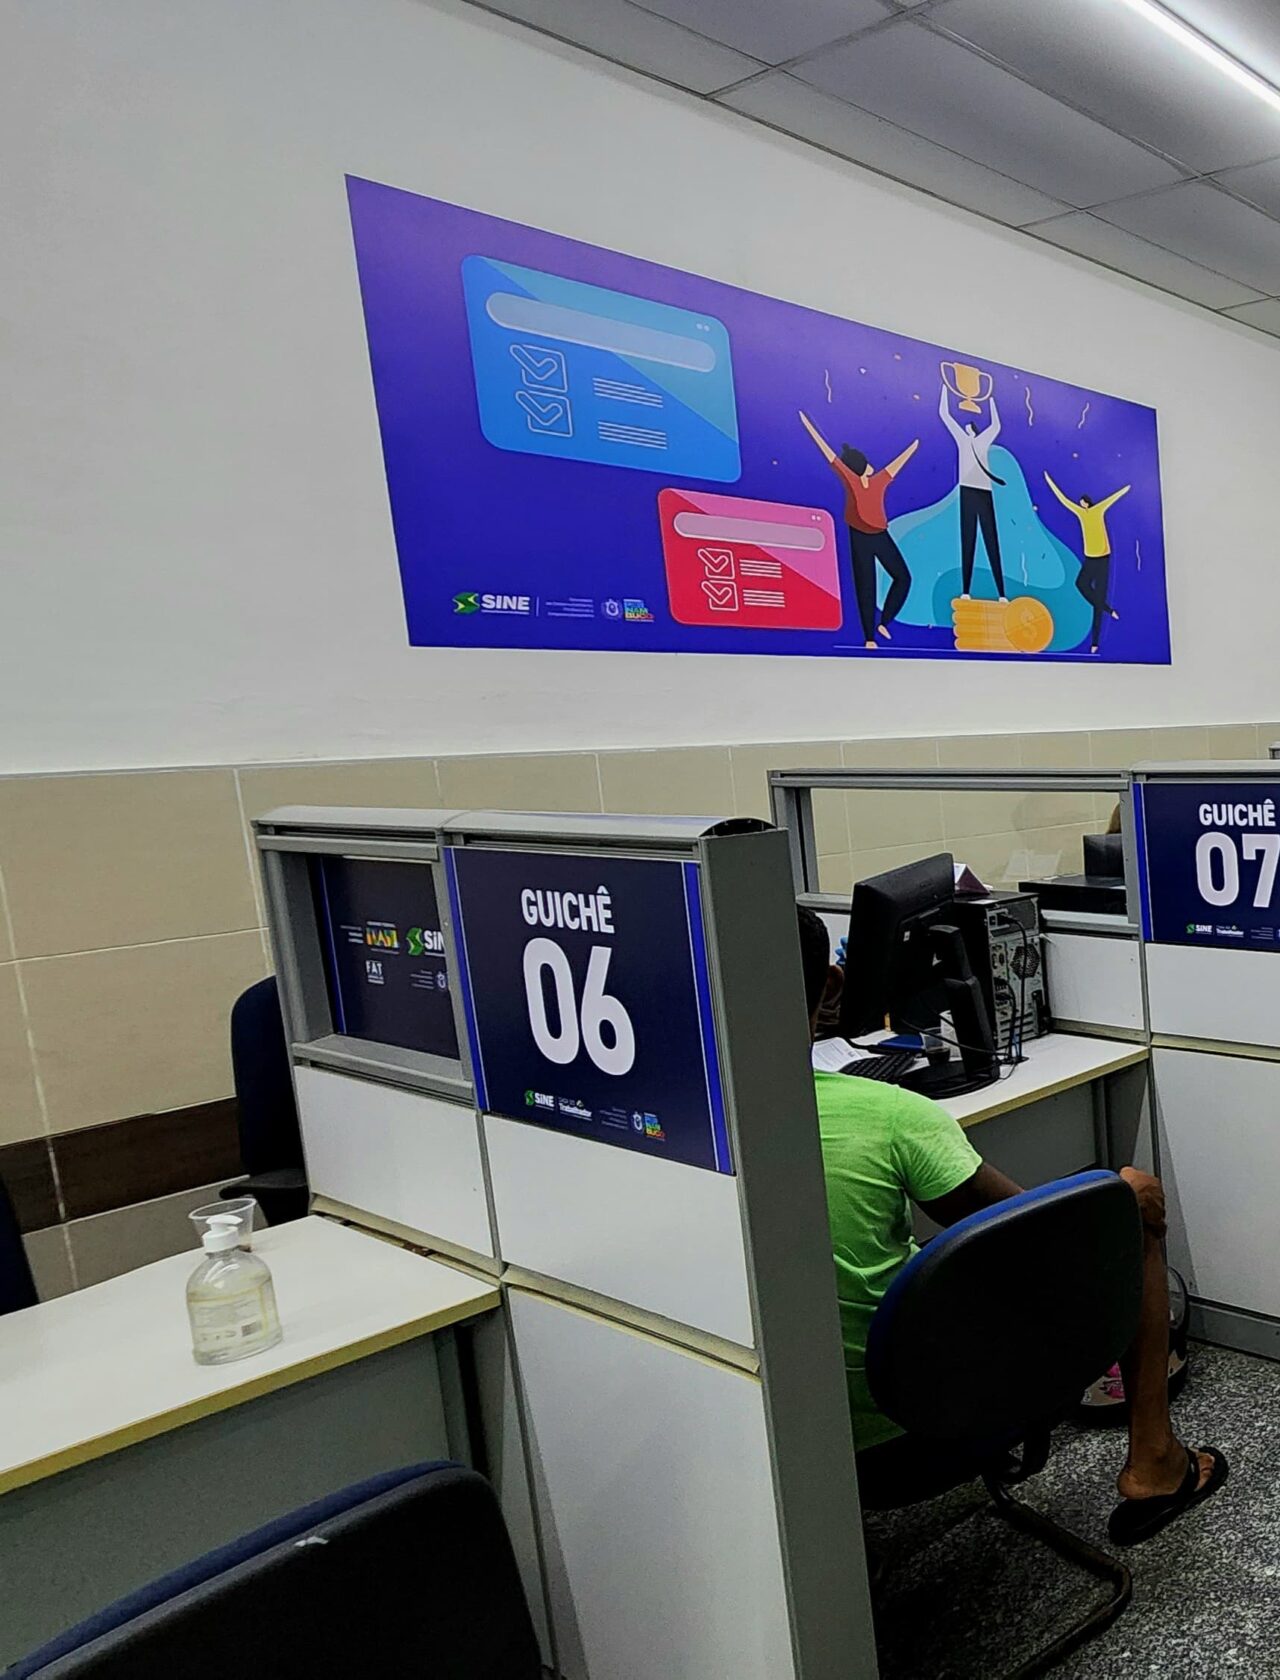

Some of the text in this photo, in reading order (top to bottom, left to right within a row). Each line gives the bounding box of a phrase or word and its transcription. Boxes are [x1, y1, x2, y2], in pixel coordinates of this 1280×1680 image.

[481, 594, 530, 611] SINE
[1199, 798, 1276, 827] GUICHÊ
[1195, 831, 1280, 908] 07
[521, 885, 615, 934] GUICHÊ
[522, 937, 636, 1076] 06
